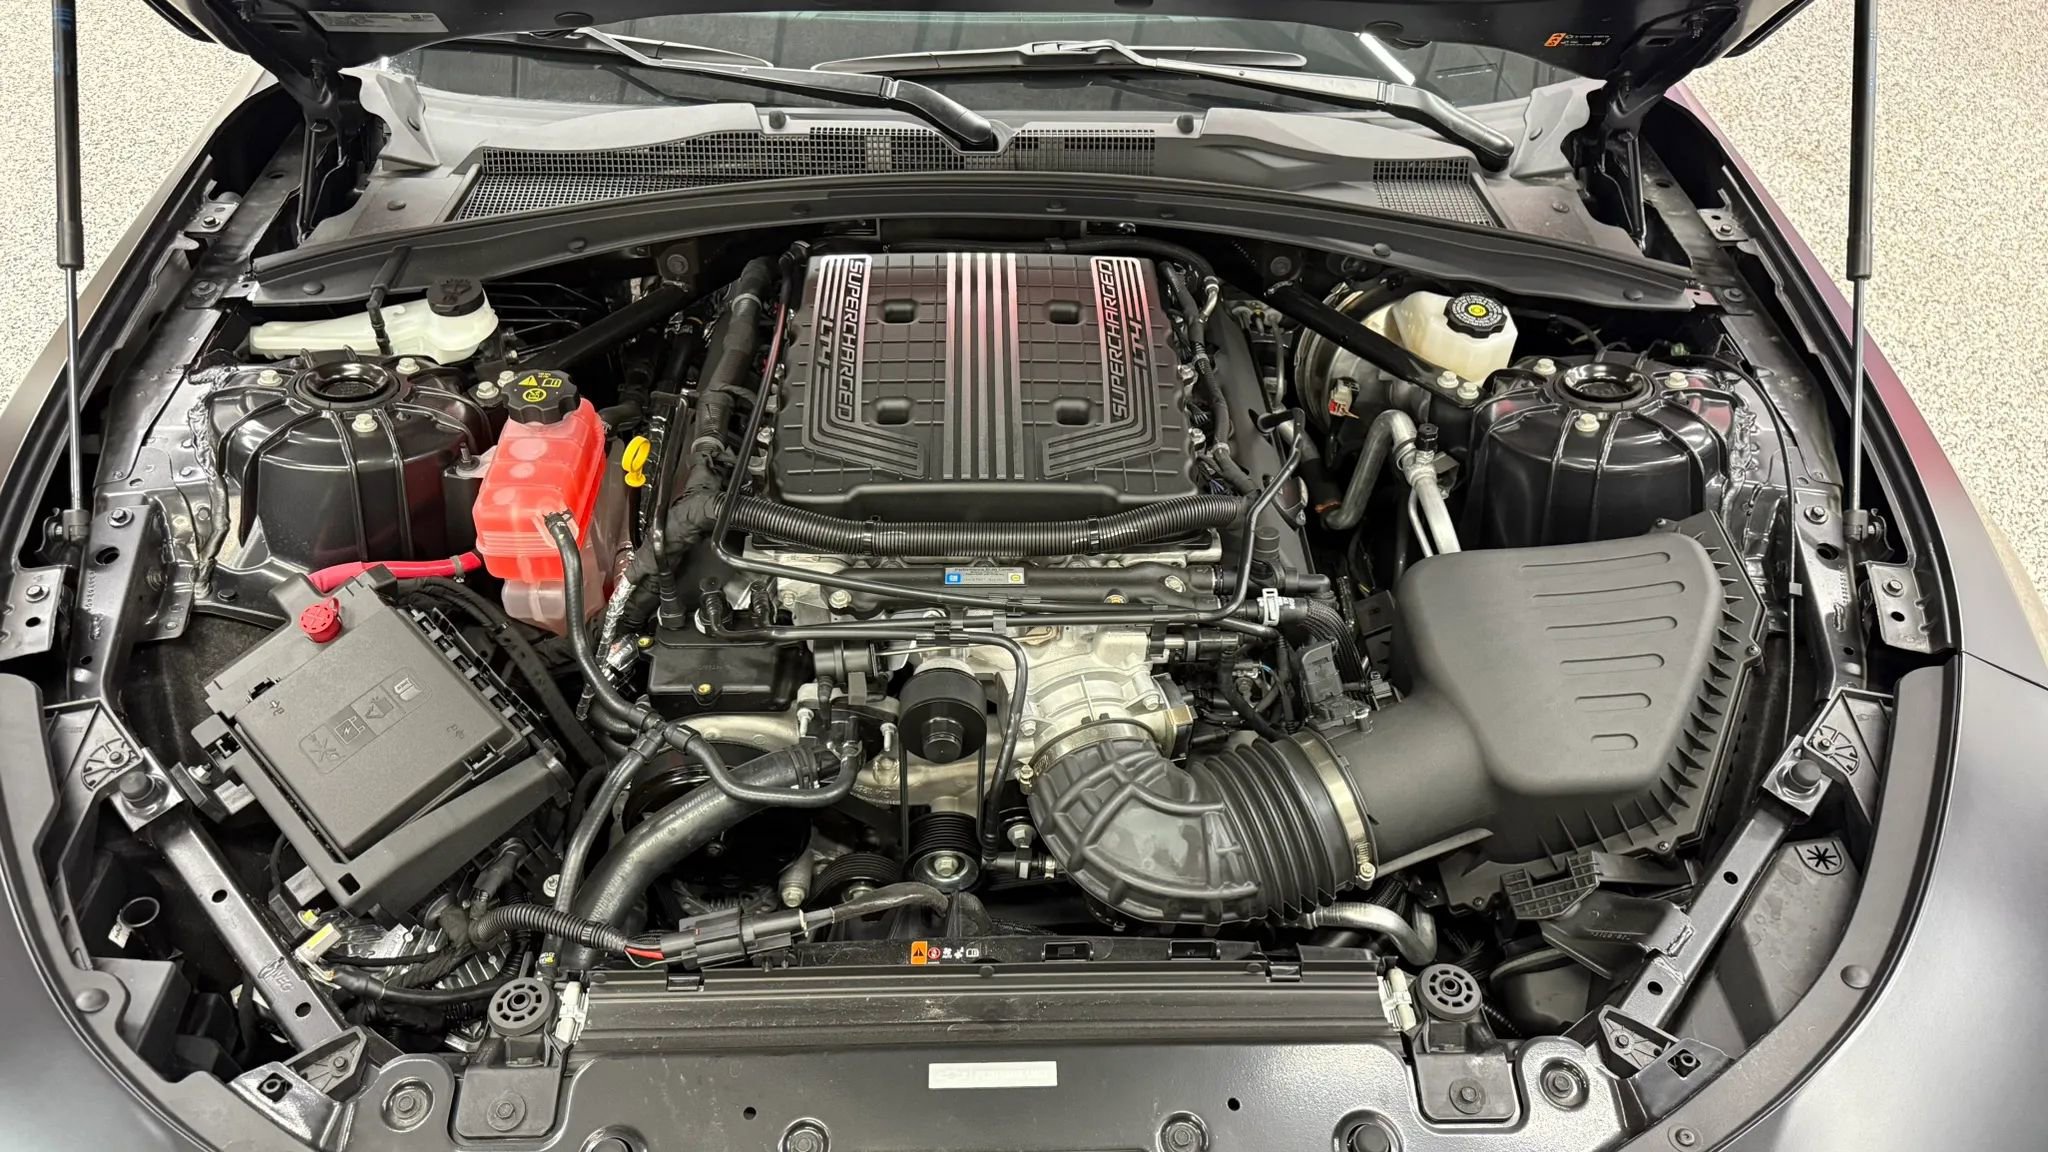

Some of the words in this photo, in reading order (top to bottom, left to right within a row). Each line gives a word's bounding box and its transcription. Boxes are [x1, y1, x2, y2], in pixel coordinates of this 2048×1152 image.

[817, 319, 834, 366] LT4
[837, 259, 864, 422] SUPERCHARGED
[1098, 260, 1128, 419] SUPERCHARGED
[1129, 320, 1148, 368] LT4
